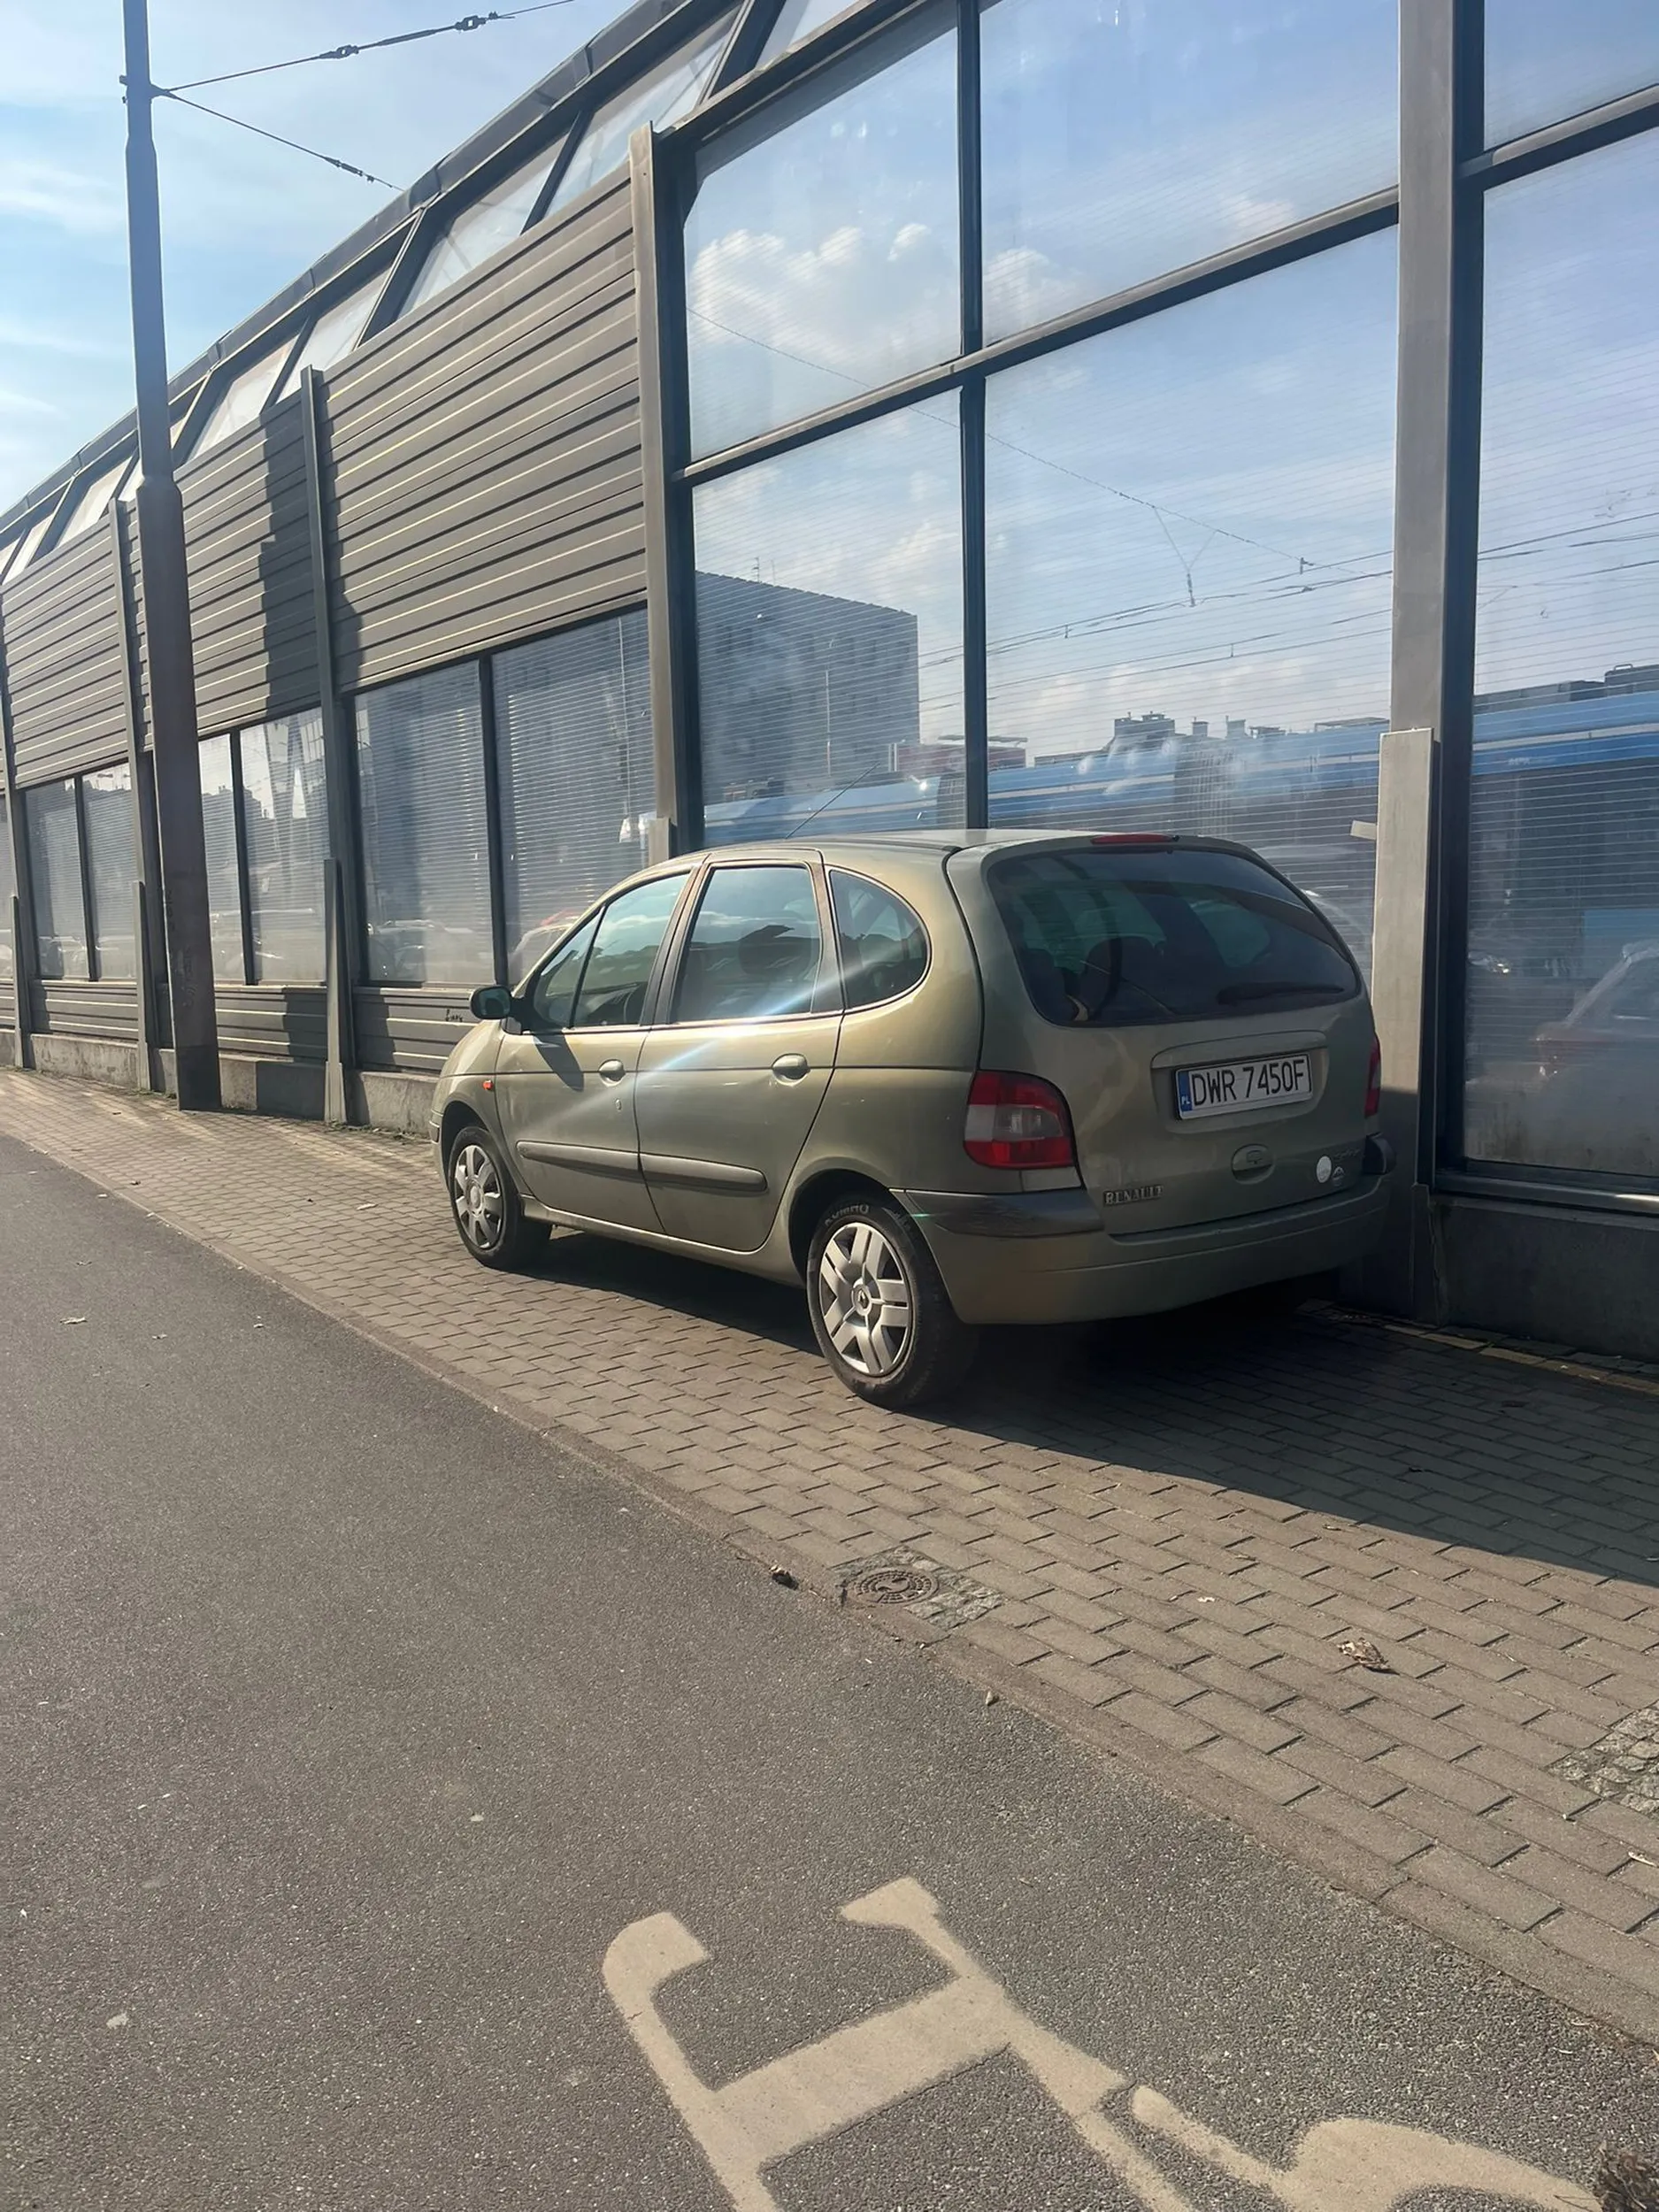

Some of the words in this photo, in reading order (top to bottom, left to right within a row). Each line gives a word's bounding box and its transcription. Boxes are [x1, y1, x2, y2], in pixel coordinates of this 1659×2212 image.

[1191, 1069, 1237, 1106] DWR
[1242, 1059, 1305, 1098] 7450F
[1181, 1095, 1191, 1105] PL
